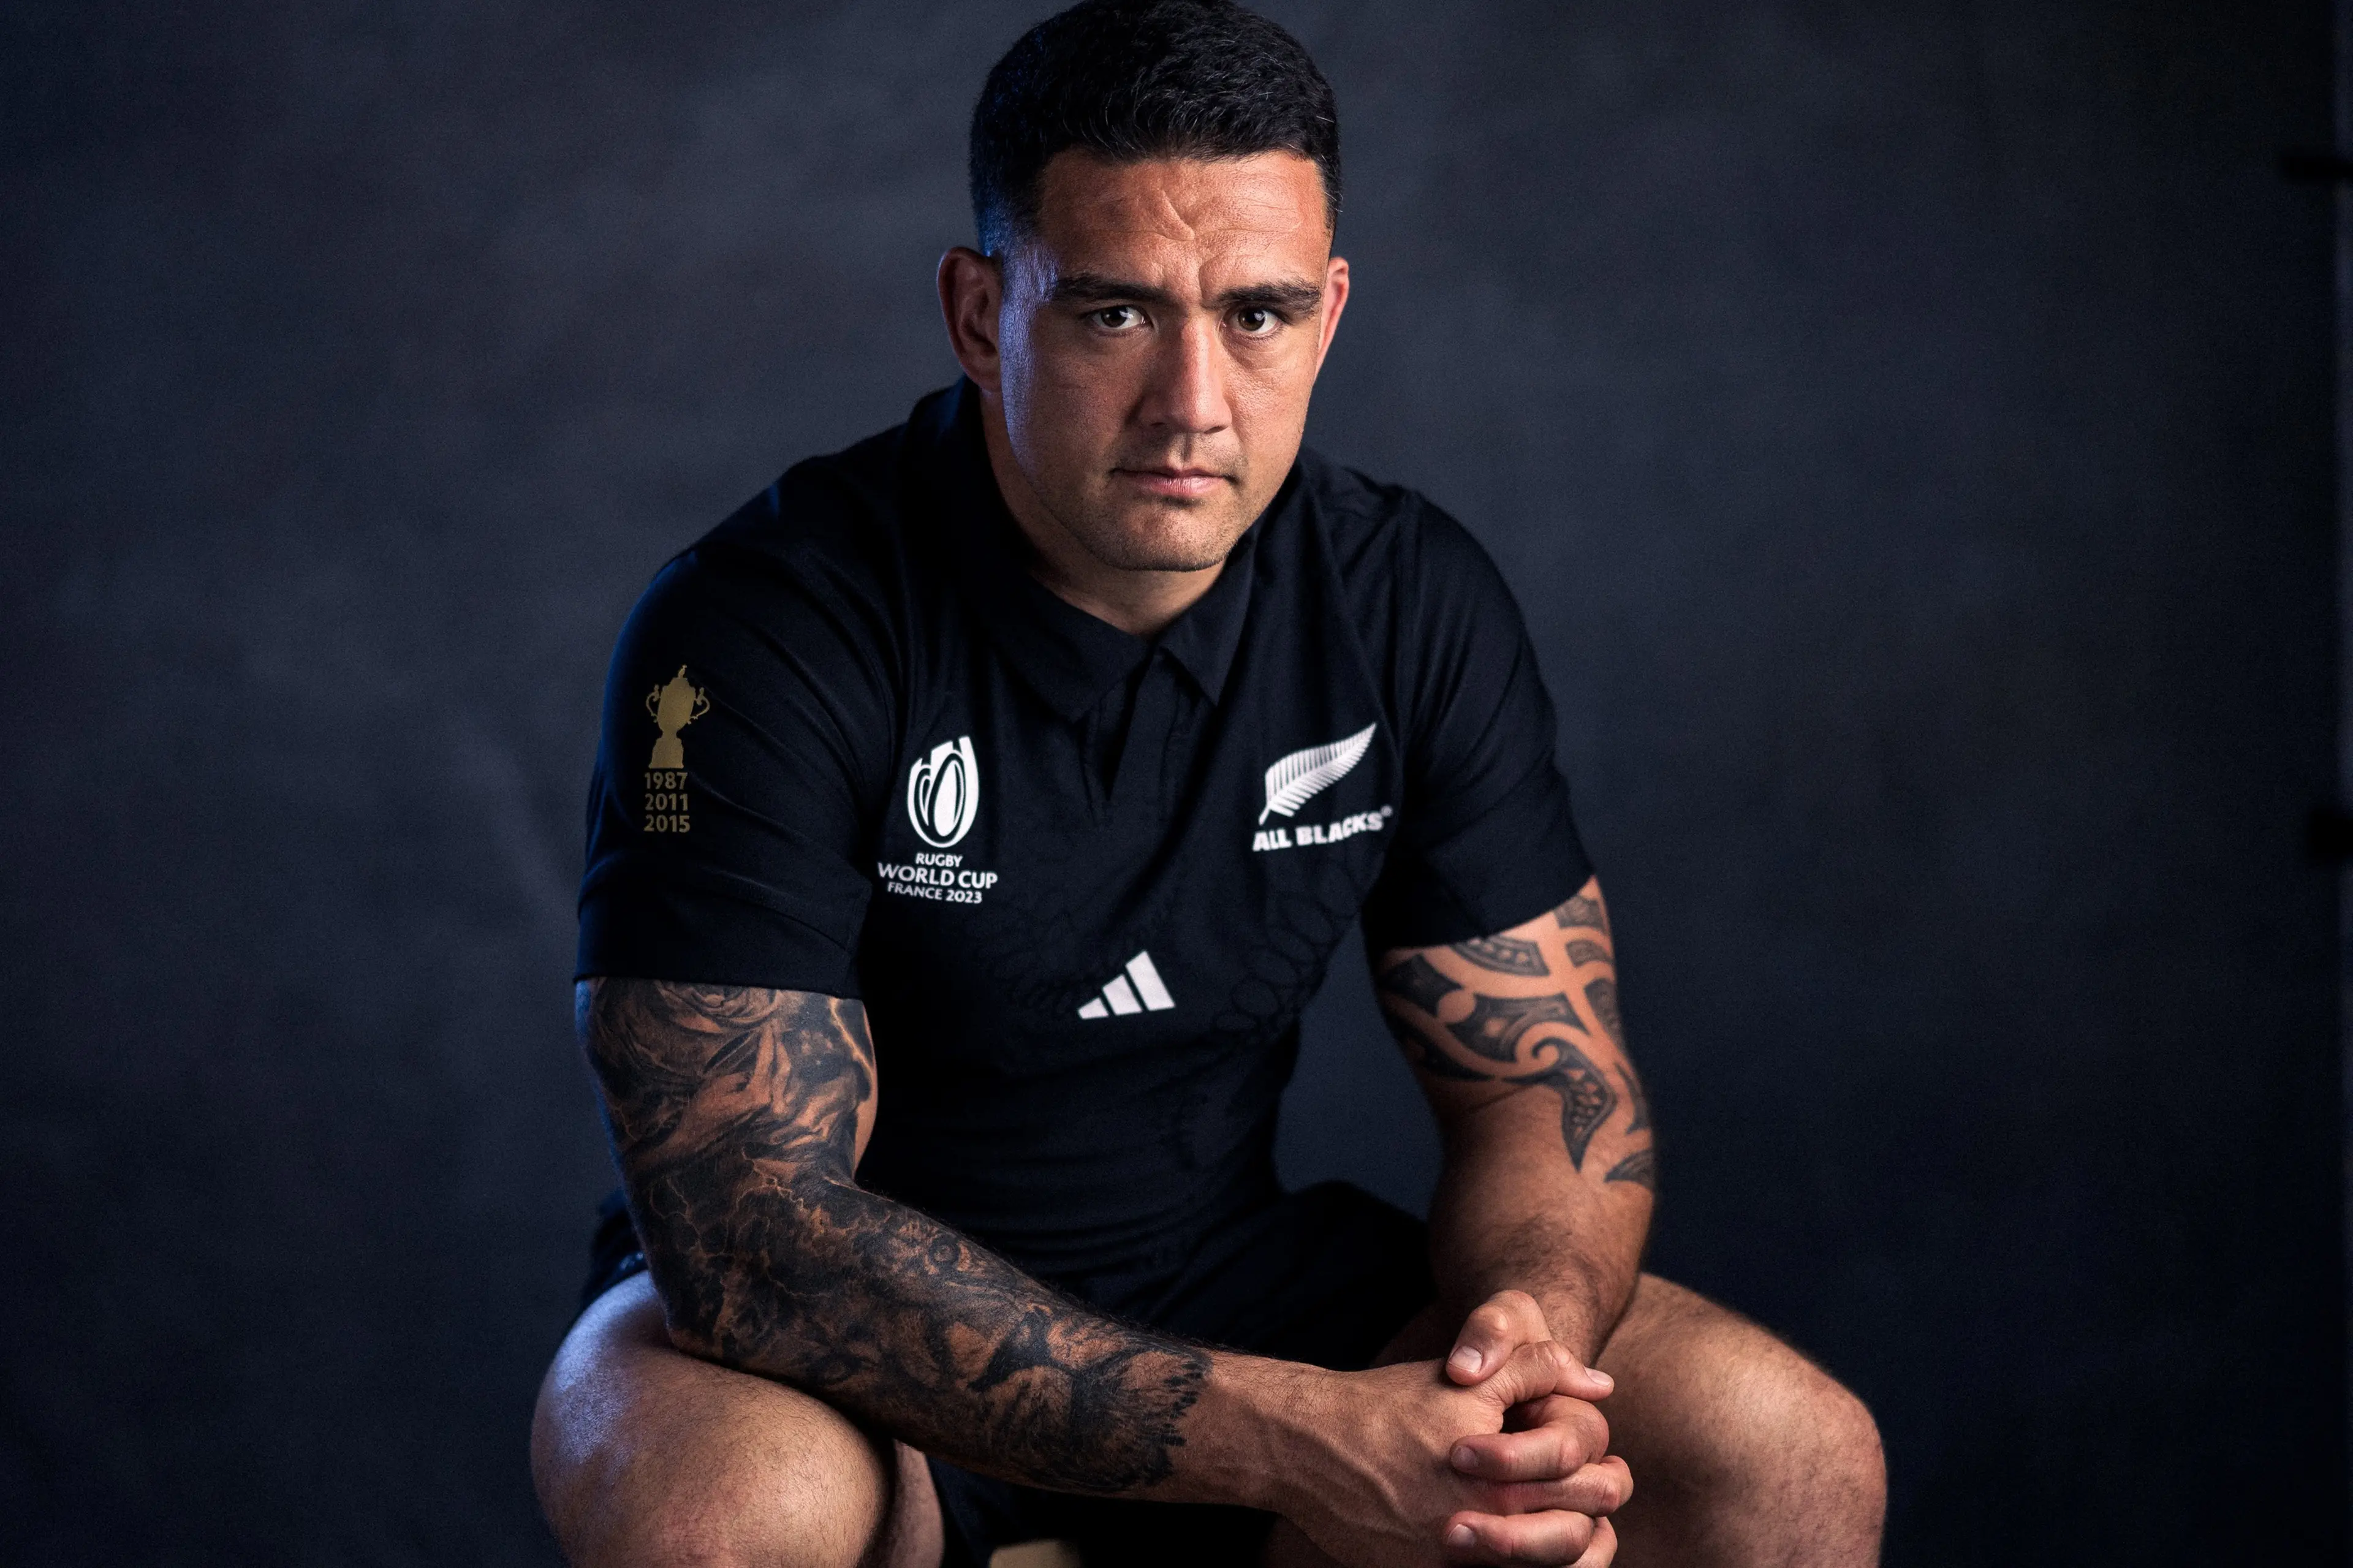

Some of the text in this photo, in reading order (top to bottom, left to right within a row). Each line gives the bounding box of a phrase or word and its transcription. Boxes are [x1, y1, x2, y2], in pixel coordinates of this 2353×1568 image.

[644, 771, 688, 790] 1987
[645, 793, 688, 811] 2011
[643, 814, 691, 833] 2015
[1252, 828, 1292, 852] ALL
[915, 853, 963, 868] RUGBY
[877, 862, 998, 888] WORLD CUP
[887, 881, 982, 904] FRANCE 2023
